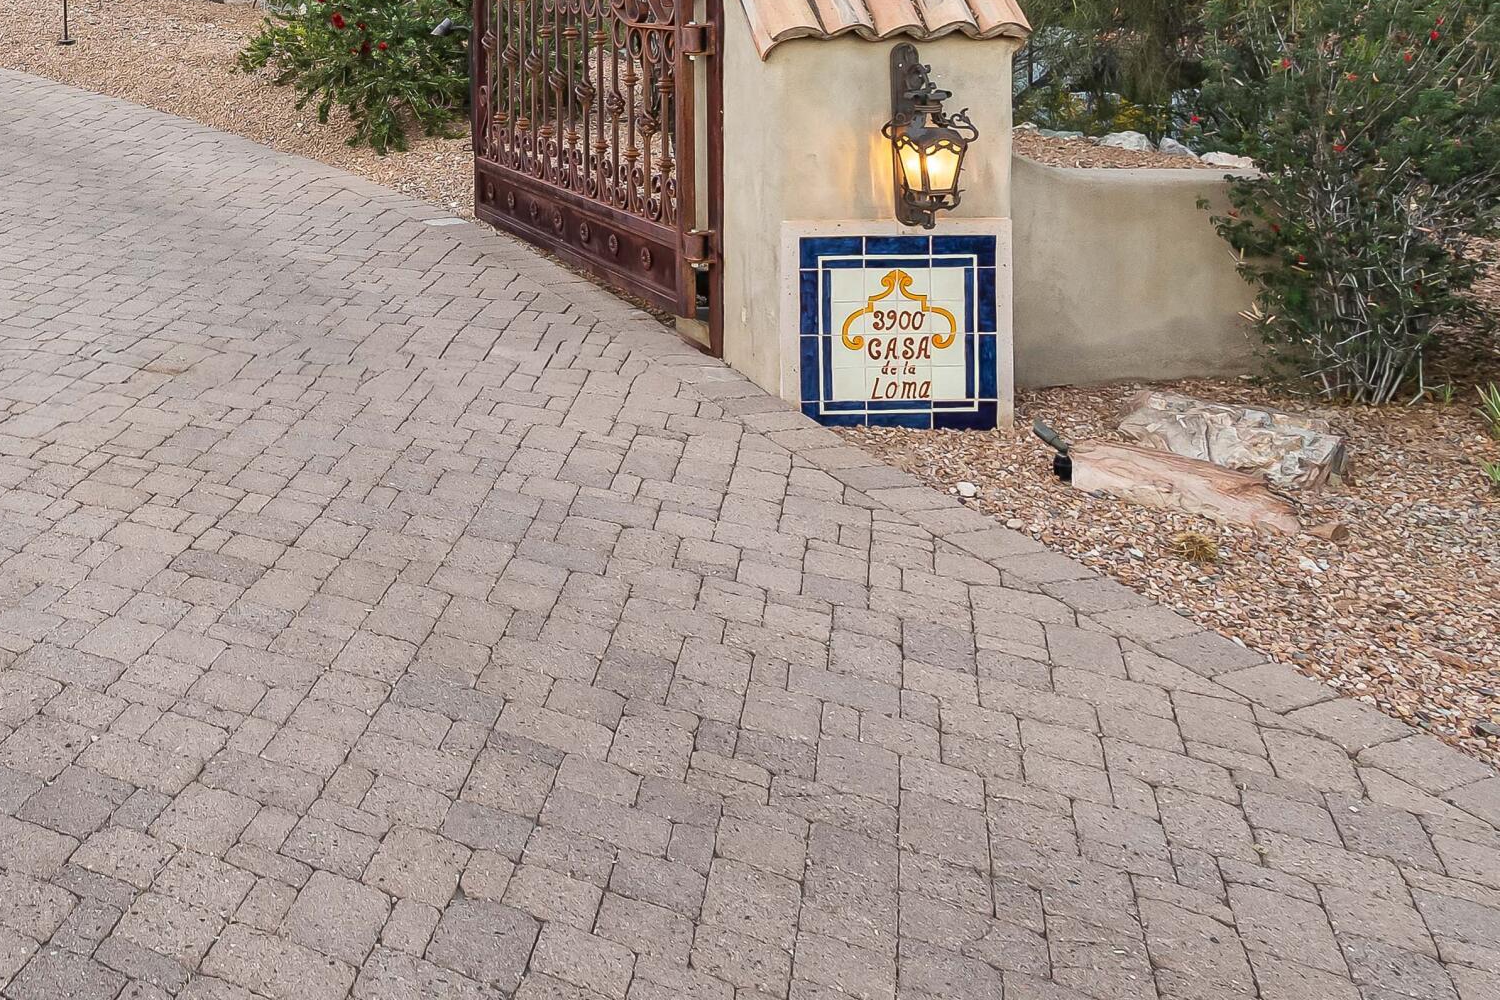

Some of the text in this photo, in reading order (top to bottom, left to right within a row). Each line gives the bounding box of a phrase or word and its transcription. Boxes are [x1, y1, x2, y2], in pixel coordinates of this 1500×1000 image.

[872, 309, 926, 331] 3900
[867, 335, 931, 361] CASA
[881, 360, 916, 375] de la
[871, 377, 931, 400] Loma
